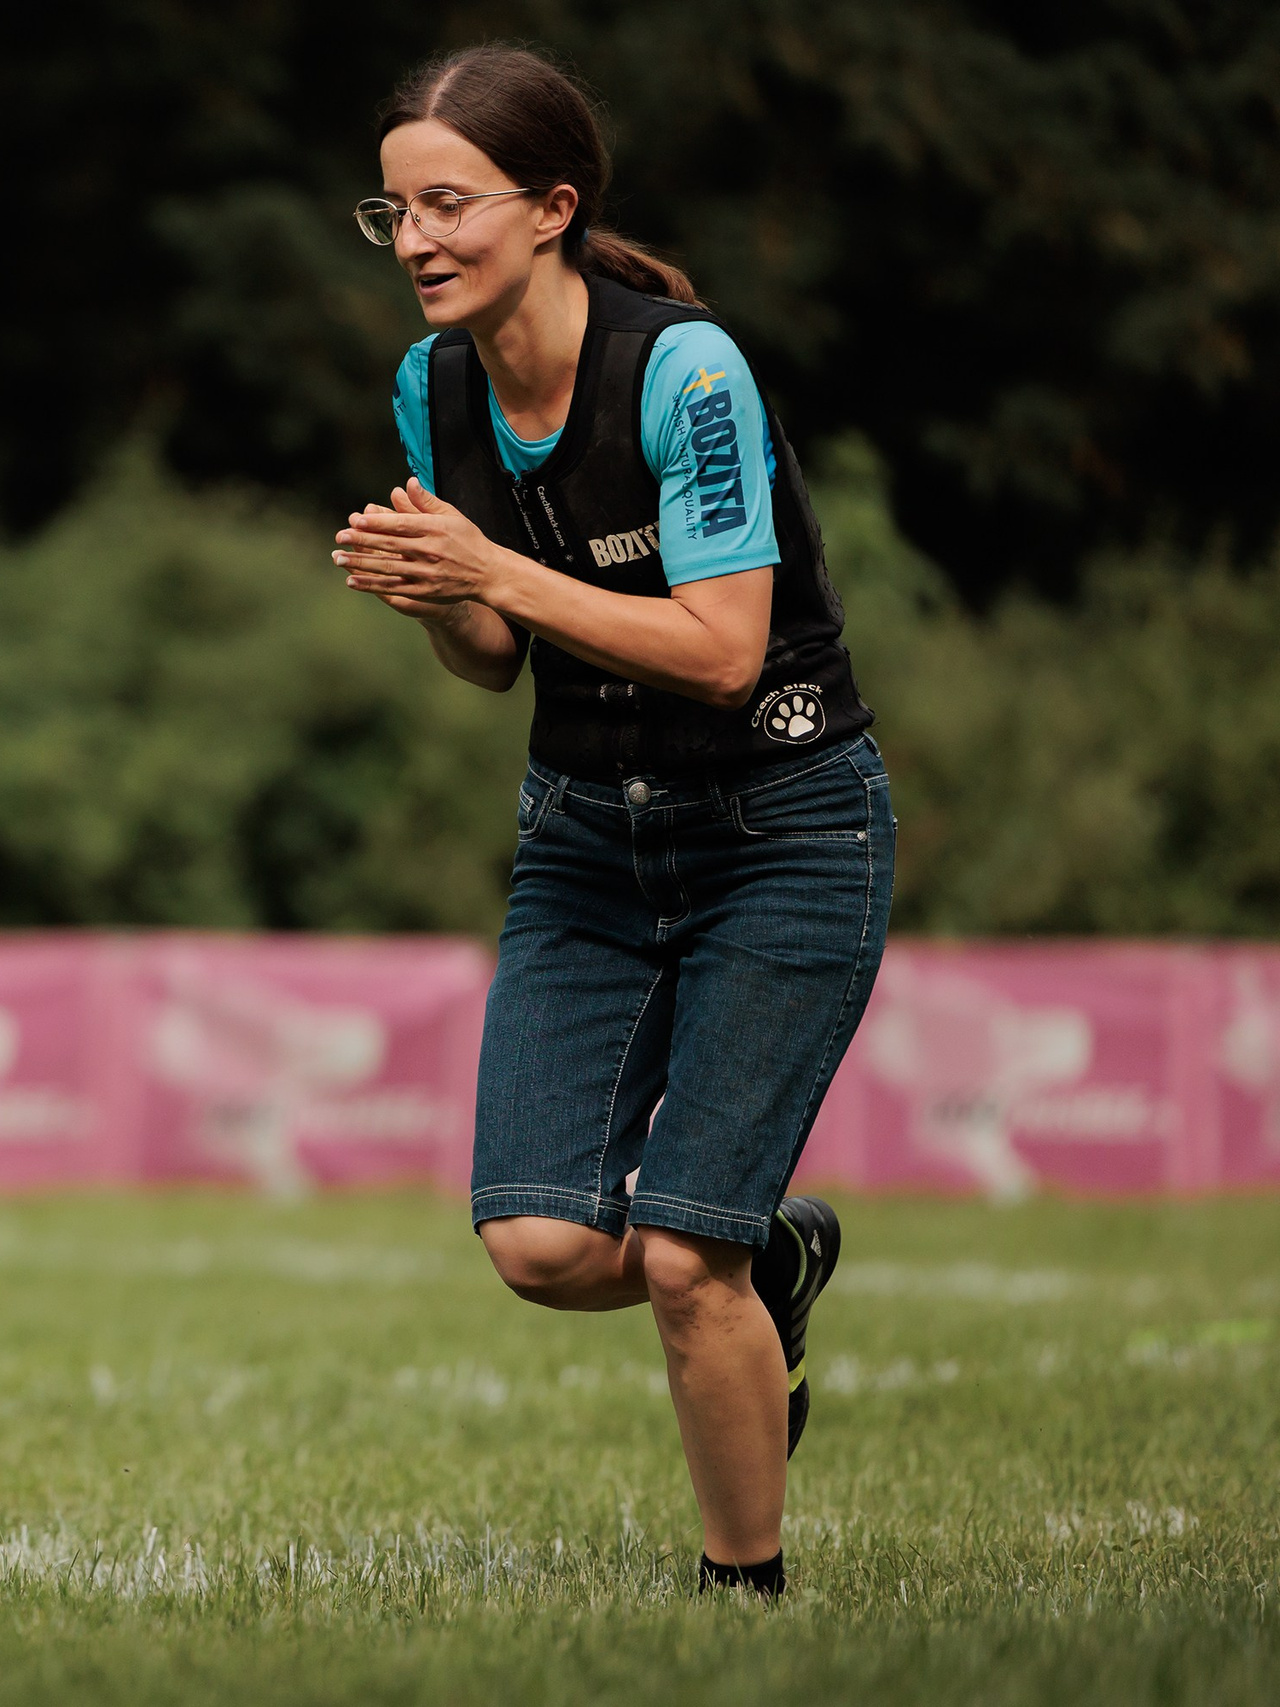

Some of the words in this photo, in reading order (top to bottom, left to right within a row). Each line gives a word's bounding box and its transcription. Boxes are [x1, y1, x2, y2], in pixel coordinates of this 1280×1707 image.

[686, 389, 748, 539] BOZITA
[536, 485, 565, 547] CzechBlack.com
[682, 489, 698, 540] QUALITY
[588, 520, 660, 568] BOZIT
[751, 690, 780, 728] Czech
